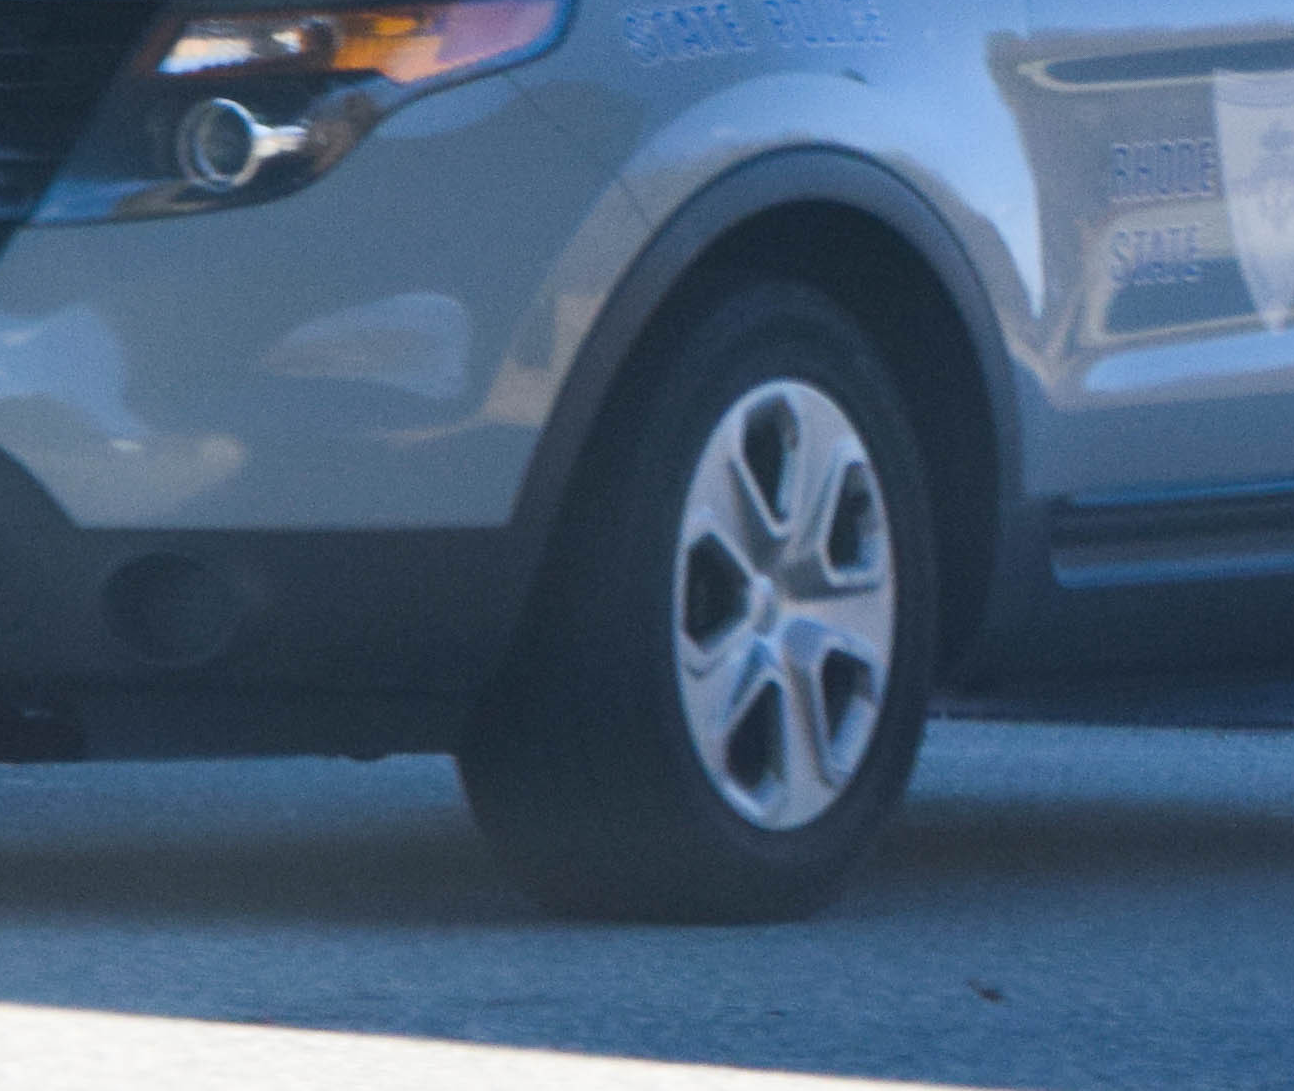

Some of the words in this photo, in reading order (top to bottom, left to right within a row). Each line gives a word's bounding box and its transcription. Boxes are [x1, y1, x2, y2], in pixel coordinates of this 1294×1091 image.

[620, 0, 755, 66] STATE
[1110, 138, 1216, 203] RHODE
[1110, 222, 1201, 286] STATE
